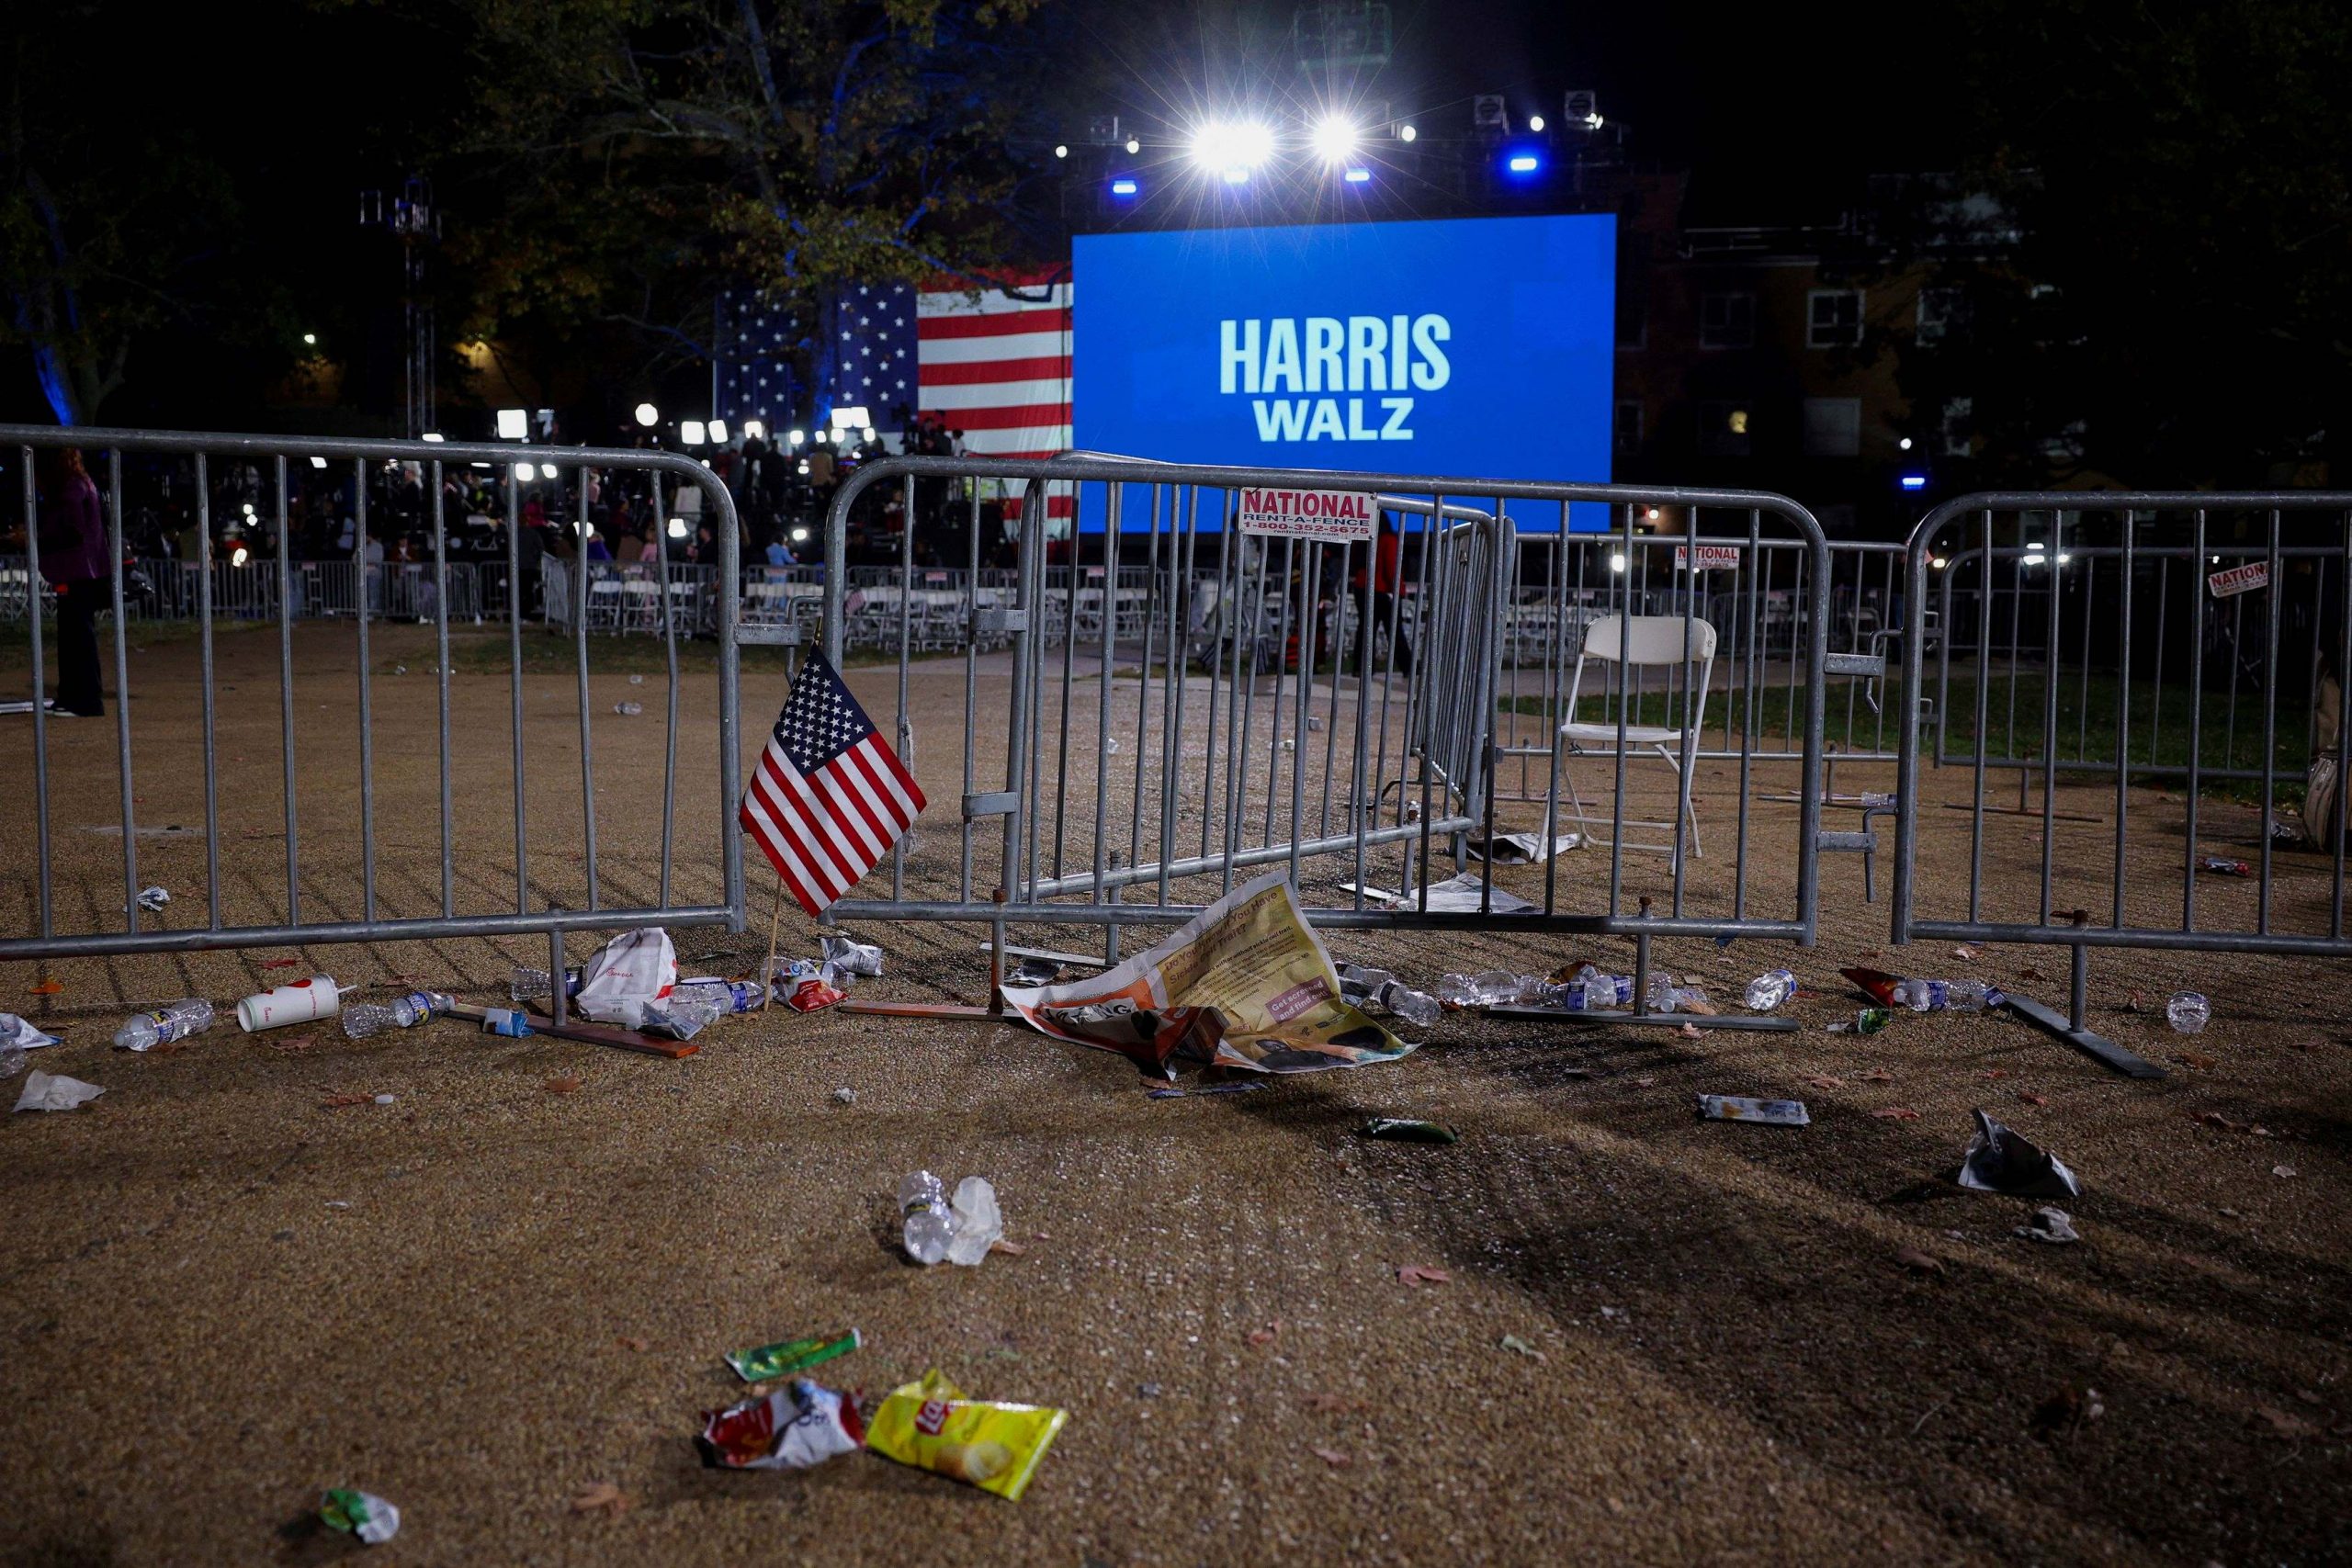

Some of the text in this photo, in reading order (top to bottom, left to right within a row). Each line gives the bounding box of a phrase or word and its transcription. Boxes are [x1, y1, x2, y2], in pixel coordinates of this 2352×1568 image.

[1220, 313, 1451, 394] HARRIS
[1252, 397, 1414, 442] WALZ
[1243, 513, 1370, 526] RENT-A-FENCE
[1244, 491, 1370, 519] NATIONAL
[1243, 522, 1370, 535] 1-800-352-5675
[1678, 547, 1737, 559] NTIONAL
[2211, 563, 2267, 588] NATION
[1165, 958, 1179, 972] Do
[1179, 947, 1198, 961] You
[1197, 928, 1223, 948] Know
[1232, 908, 1250, 924] You
[1251, 891, 1278, 912] Have
[1215, 958, 1227, 967] with
[1232, 944, 1252, 958] without
[1251, 937, 1269, 948] sickle
[1267, 931, 1279, 940] cell
[1277, 924, 1293, 934] trait.
[1170, 961, 1199, 984] Sickle
[1217, 923, 1247, 946] Trait?
[1272, 980, 1324, 1011] Get screened
[1279, 1007, 1295, 1021] and
[1295, 996, 1312, 1011] find
